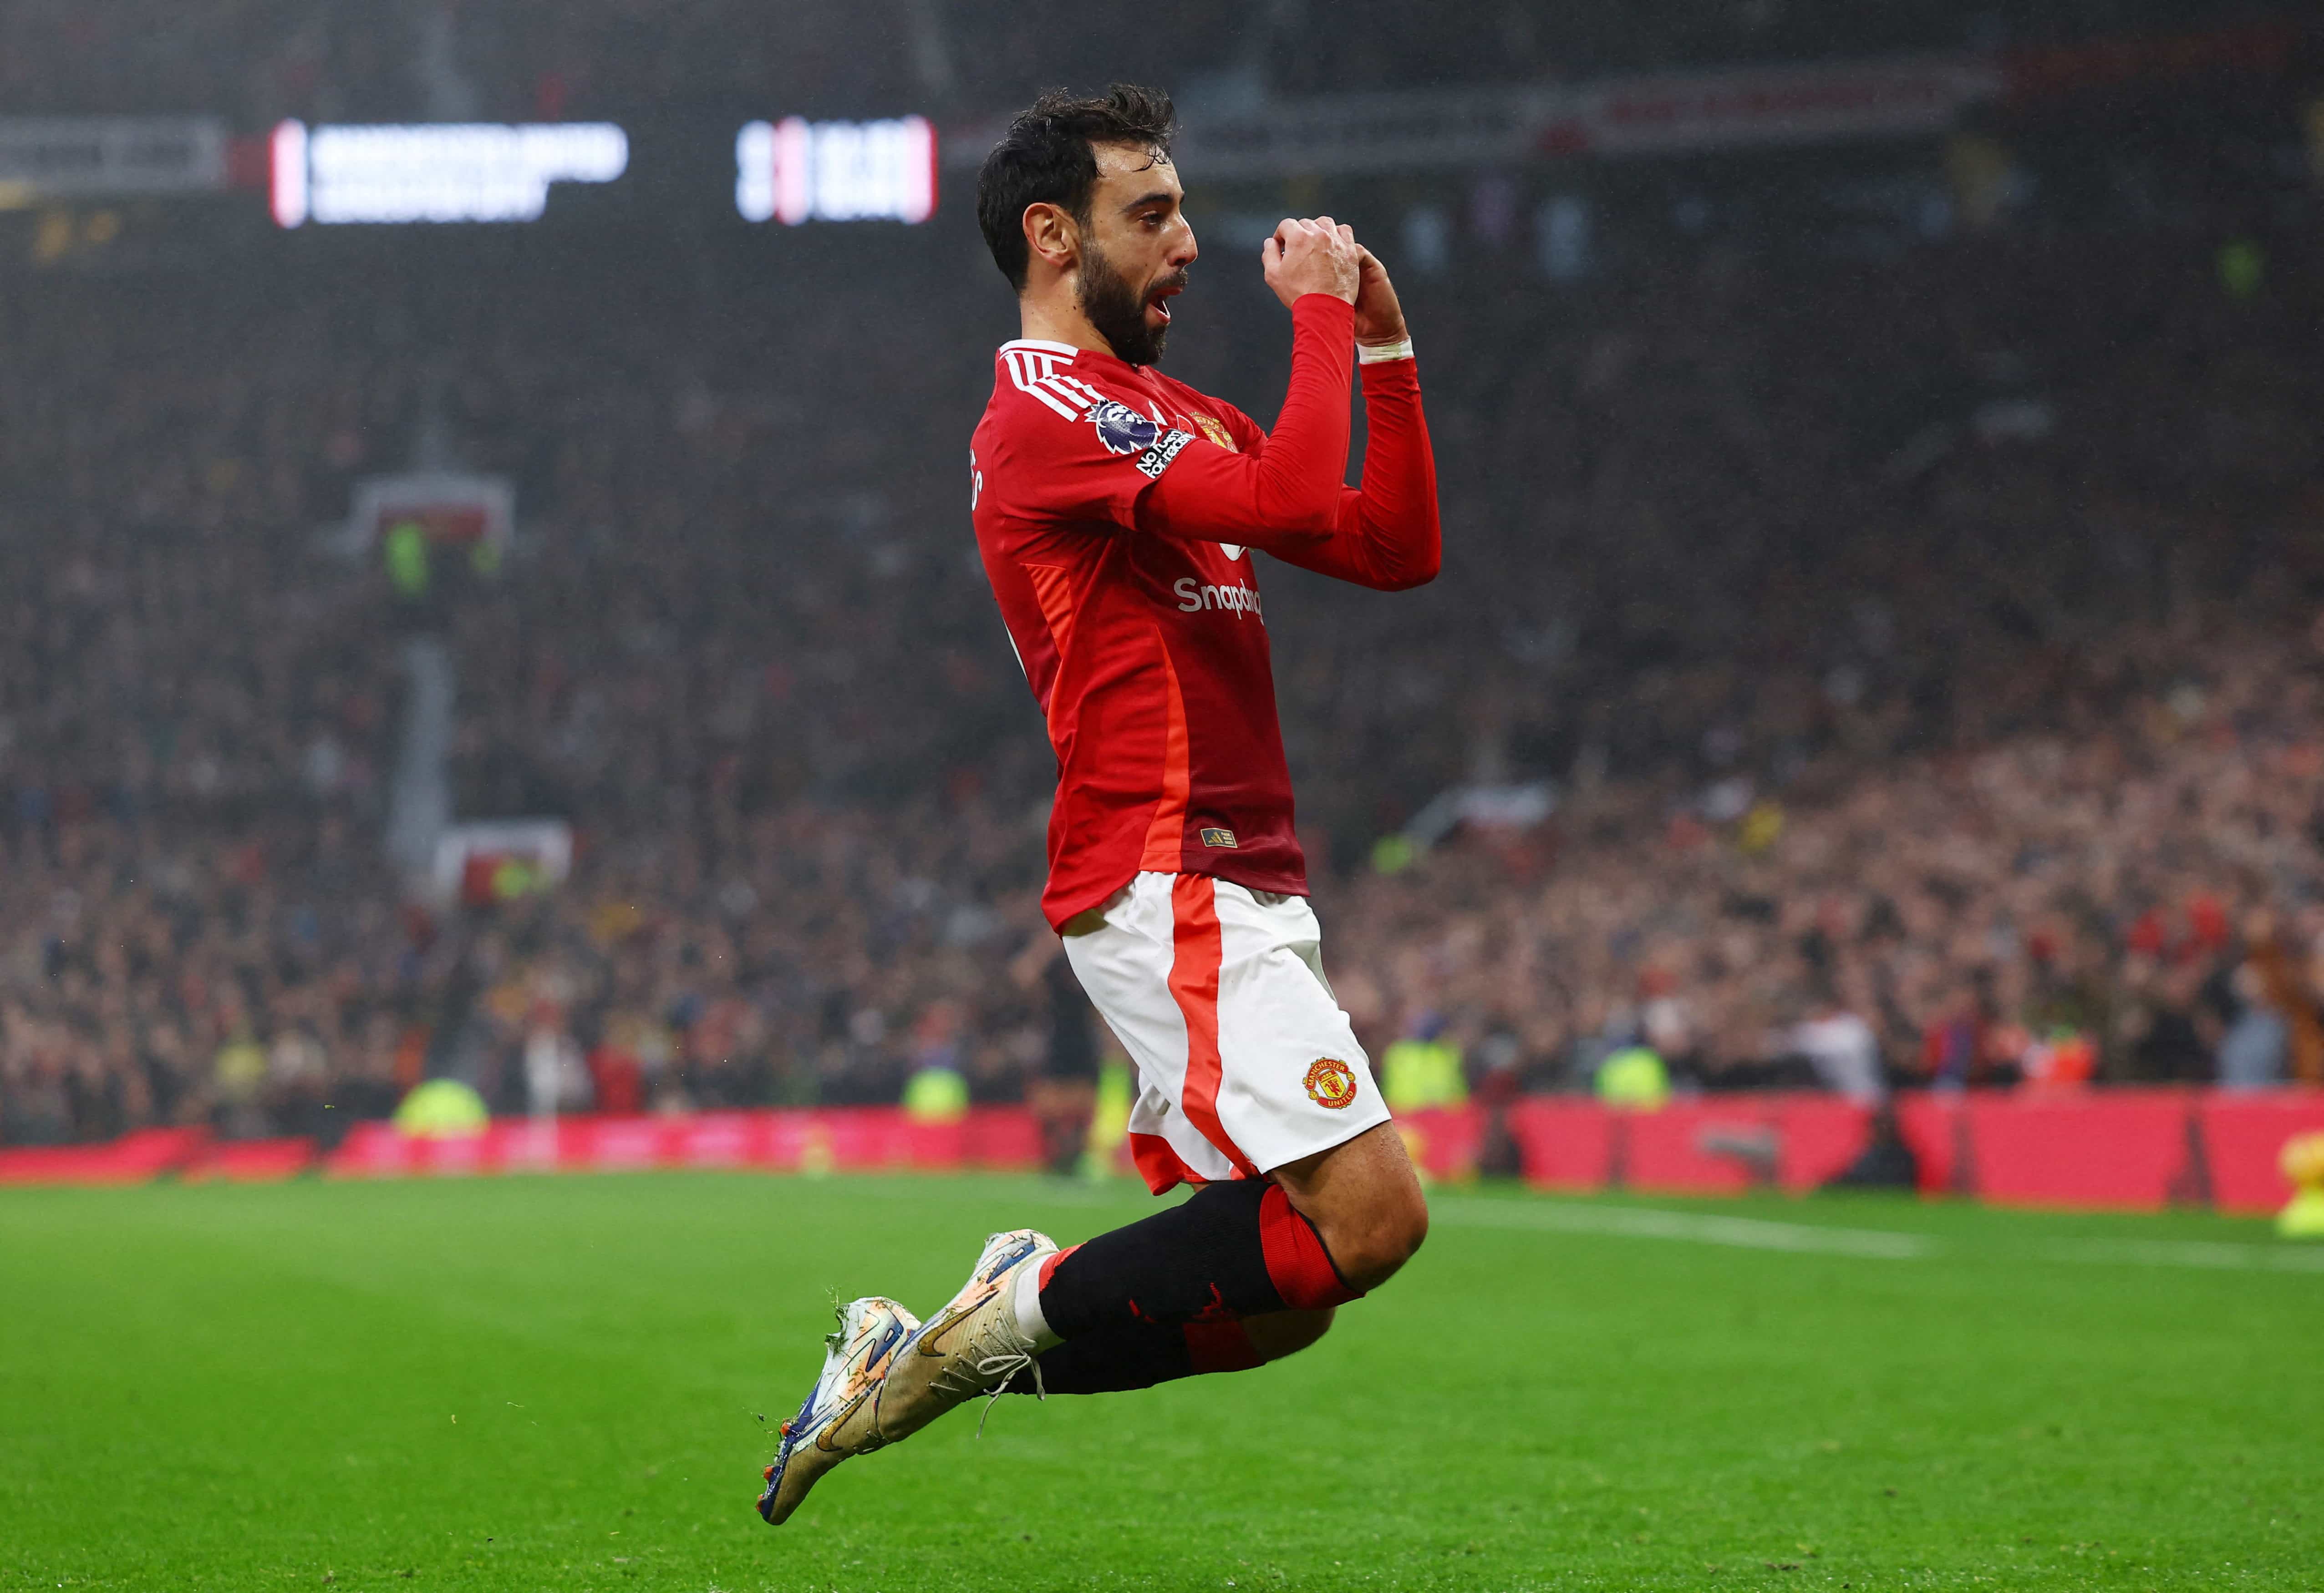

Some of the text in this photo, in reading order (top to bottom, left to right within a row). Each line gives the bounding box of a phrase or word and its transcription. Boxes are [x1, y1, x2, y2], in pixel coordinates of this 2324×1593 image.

[1135, 431, 1183, 474] No rom
[1147, 458, 1166, 479] for
[1308, 1061, 1345, 1086] MANCHESTER
[1328, 1091, 1353, 1106] UNITED
